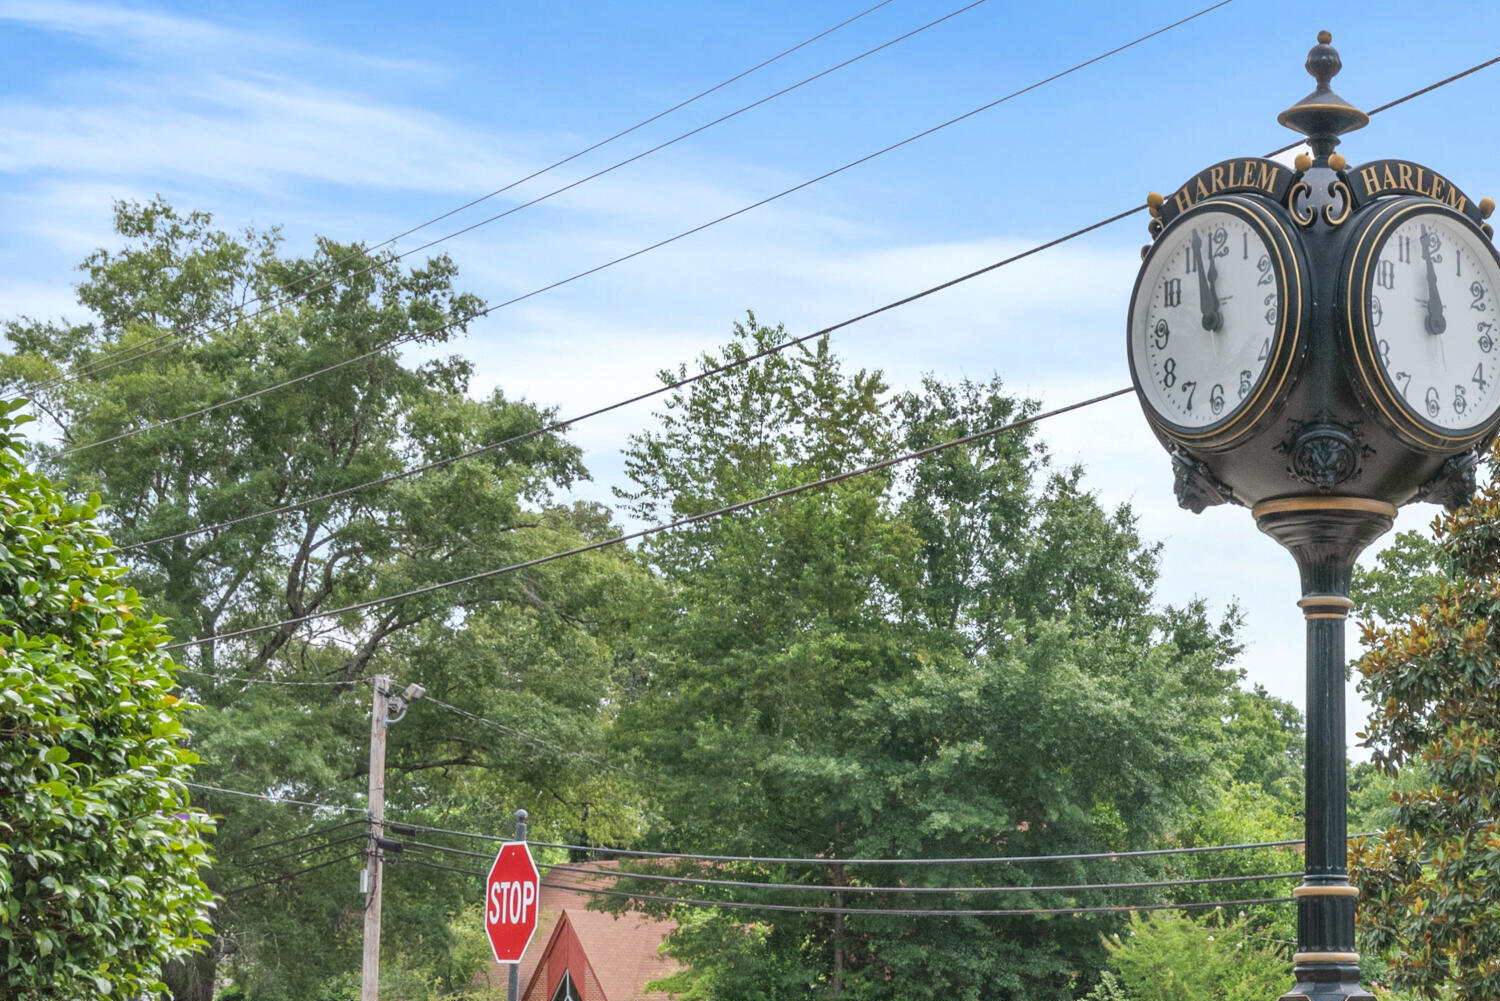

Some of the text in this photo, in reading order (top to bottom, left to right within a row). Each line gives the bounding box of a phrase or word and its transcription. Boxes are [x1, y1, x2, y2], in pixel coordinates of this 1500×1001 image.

[1174, 160, 1280, 214] HARLEM
[1360, 162, 1467, 214] HARLEM
[1208, 227, 1229, 260] 12
[1243, 232, 1248, 260] 1
[1398, 235, 1411, 264] 11
[1257, 254, 1274, 286] 2
[1377, 259, 1395, 290] 10
[1456, 249, 1461, 277] 1
[1164, 278, 1182, 308] 10
[1470, 281, 1486, 311] 2
[1154, 319, 1170, 350] 9
[1477, 321, 1494, 353] 3
[1164, 357, 1176, 388] 8
[1238, 370, 1252, 400] 5
[1396, 371, 1412, 400] 7
[1472, 362, 1487, 391] 4
[1182, 380, 1197, 411] 7
[1210, 383, 1225, 415] 6
[1425, 387, 1441, 418] 6
[1453, 384, 1467, 414] 5
[489, 881, 535, 924] STOP
